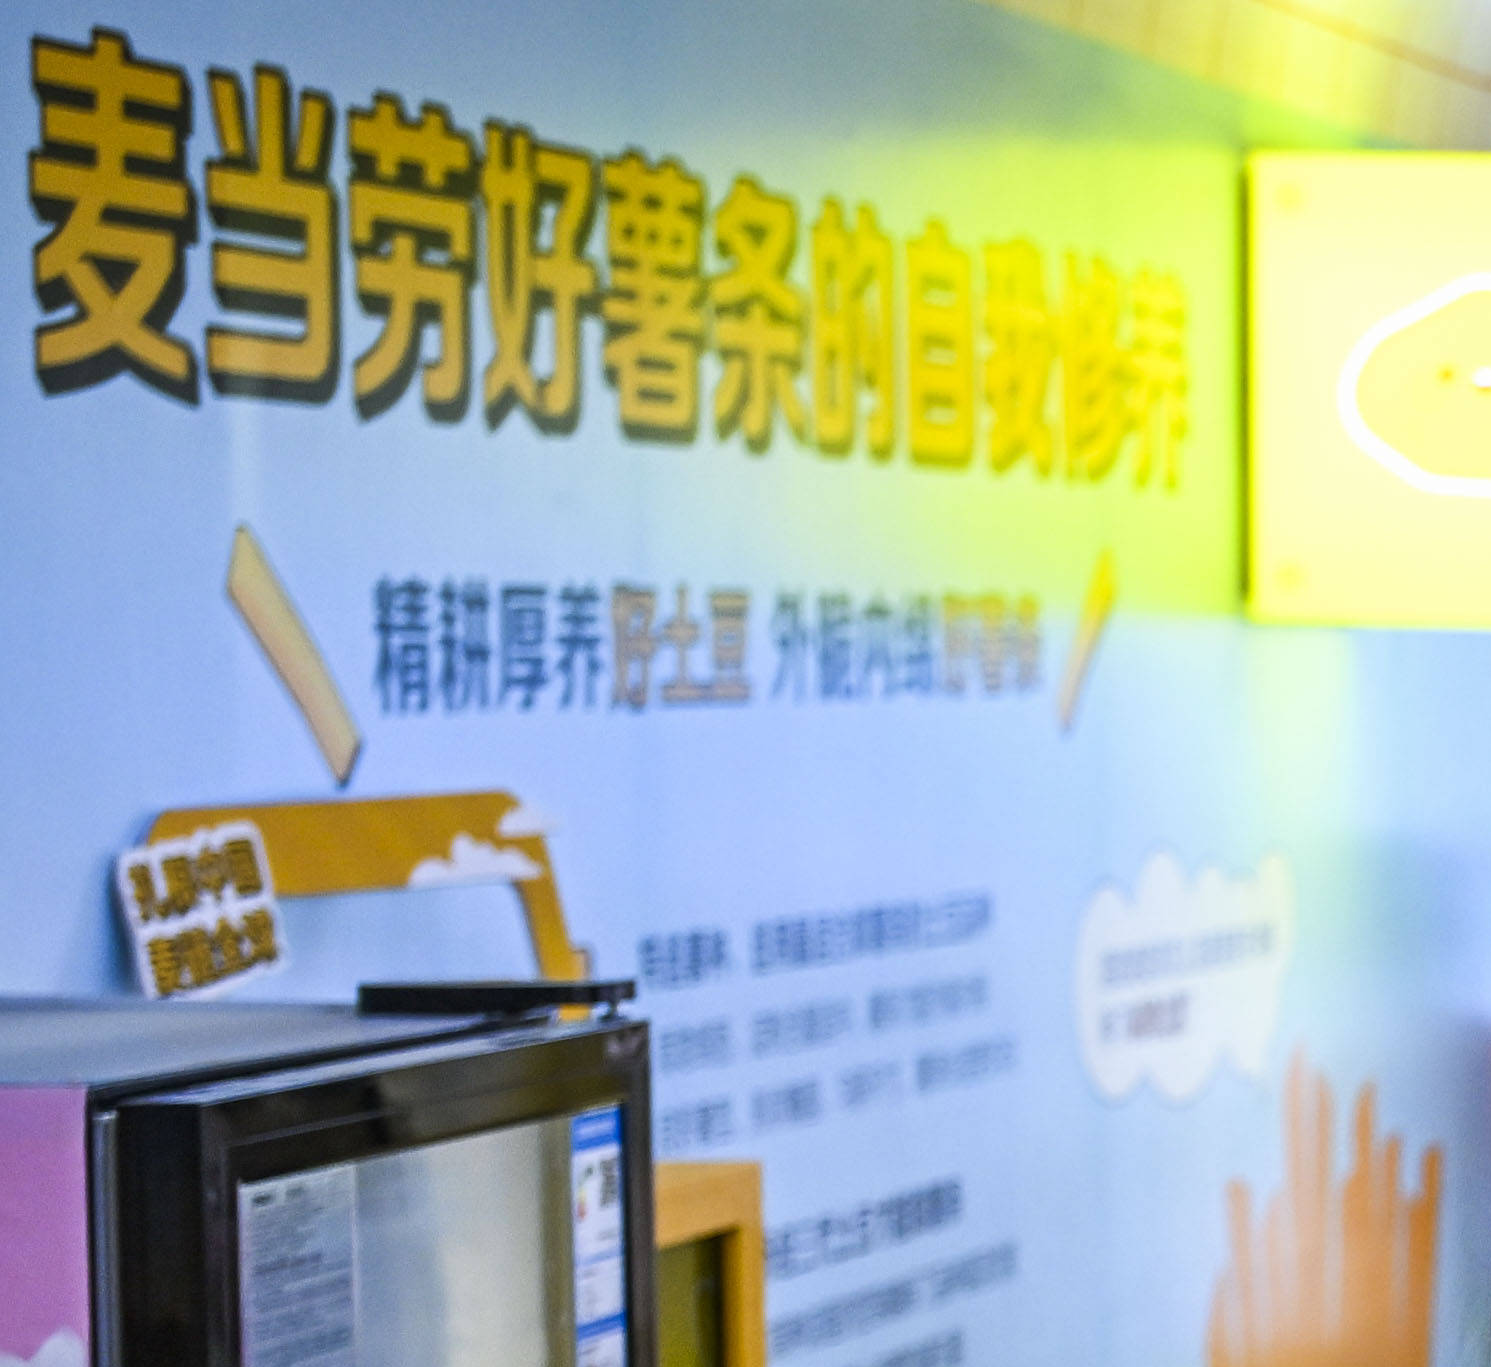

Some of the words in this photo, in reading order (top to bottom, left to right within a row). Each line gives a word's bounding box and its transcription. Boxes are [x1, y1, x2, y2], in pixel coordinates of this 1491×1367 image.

[28, 27, 1190, 494] 麦当劳好薯条的自我修养
